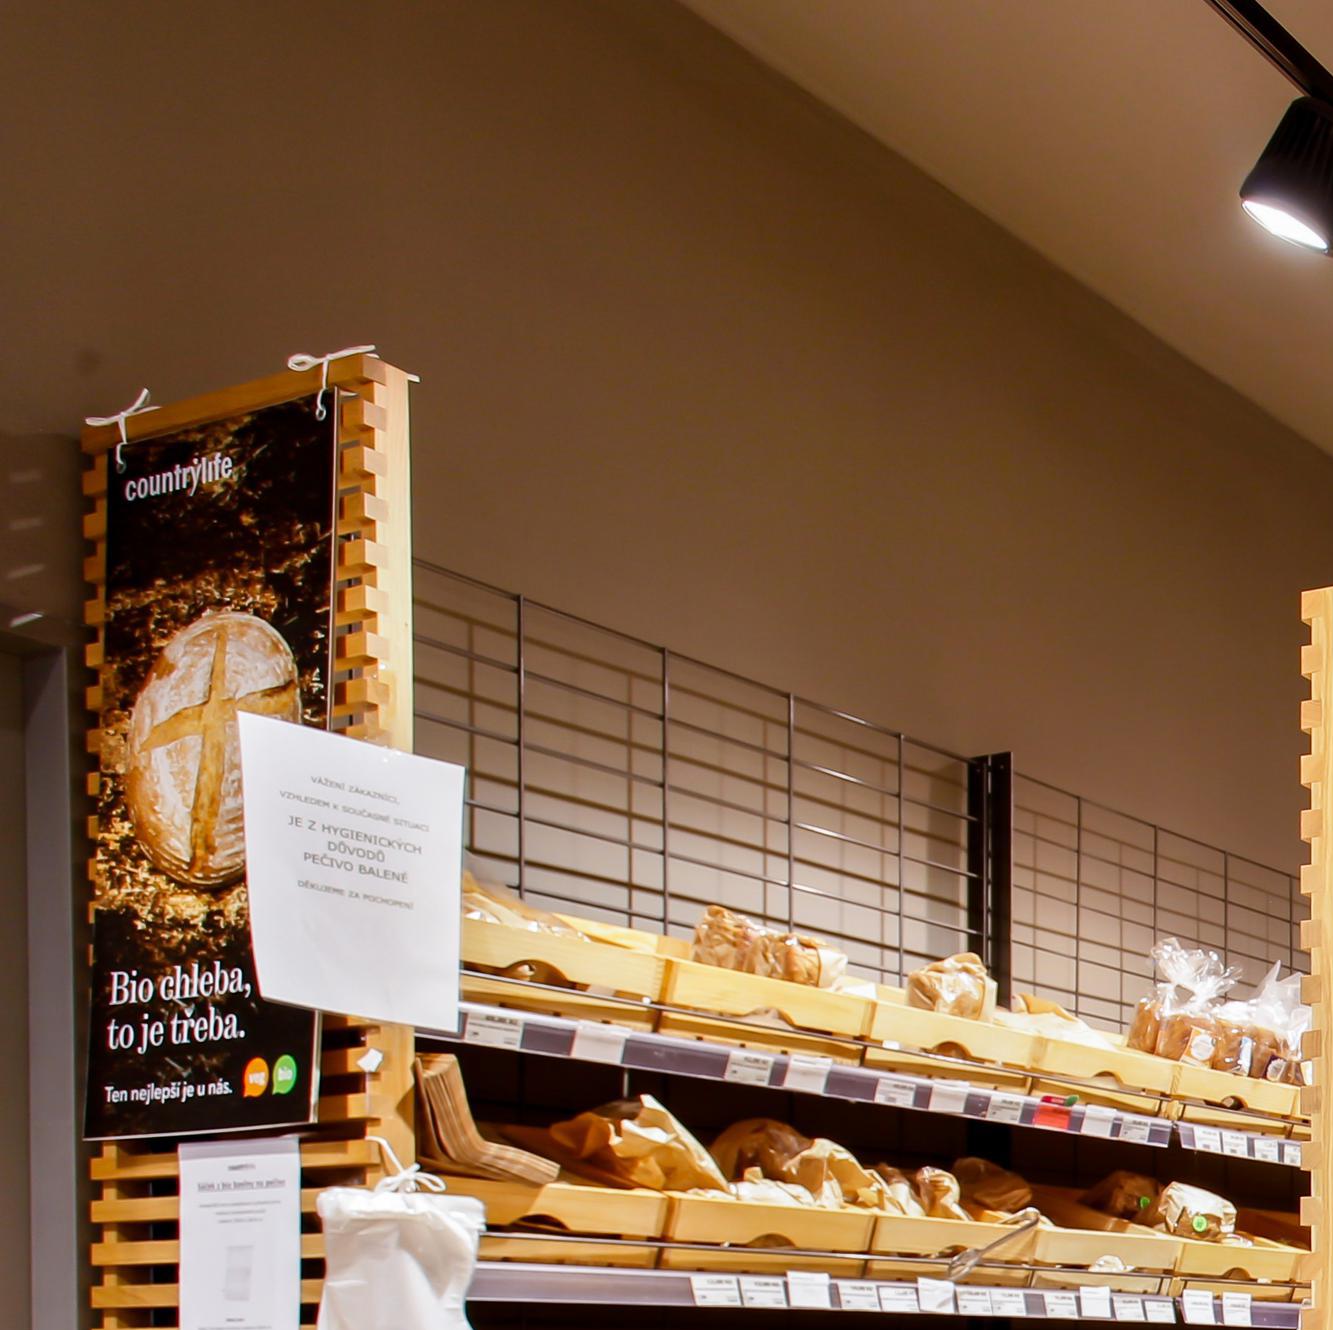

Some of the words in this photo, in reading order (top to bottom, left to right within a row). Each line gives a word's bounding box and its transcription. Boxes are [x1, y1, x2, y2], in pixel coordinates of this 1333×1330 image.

[280, 790, 330, 808] VZHLEDEM
[288, 815, 303, 828] JE
[307, 820, 317, 831] Z
[322, 824, 422, 855] HYGIENICKÝCH
[328, 840, 386, 863] DŮVODŮ
[304, 851, 354, 872] PEČIVO
[358, 864, 408, 884] BALENÉ
[349, 890, 360, 899] ZA
[109, 970, 154, 1006] Bio
[160, 961, 251, 1000] chleba,
[107, 1018, 134, 1050] to
[138, 1014, 164, 1054] je
[171, 1005, 245, 1045] třeba.
[277, 1067, 293, 1081] bio
[104, 1086, 128, 1103] Ten
[131, 1083, 179, 1105] nejlepší
[181, 1082, 194, 1102] je
[197, 1085, 205, 1096] u
[208, 1078, 232, 1095] nás.
